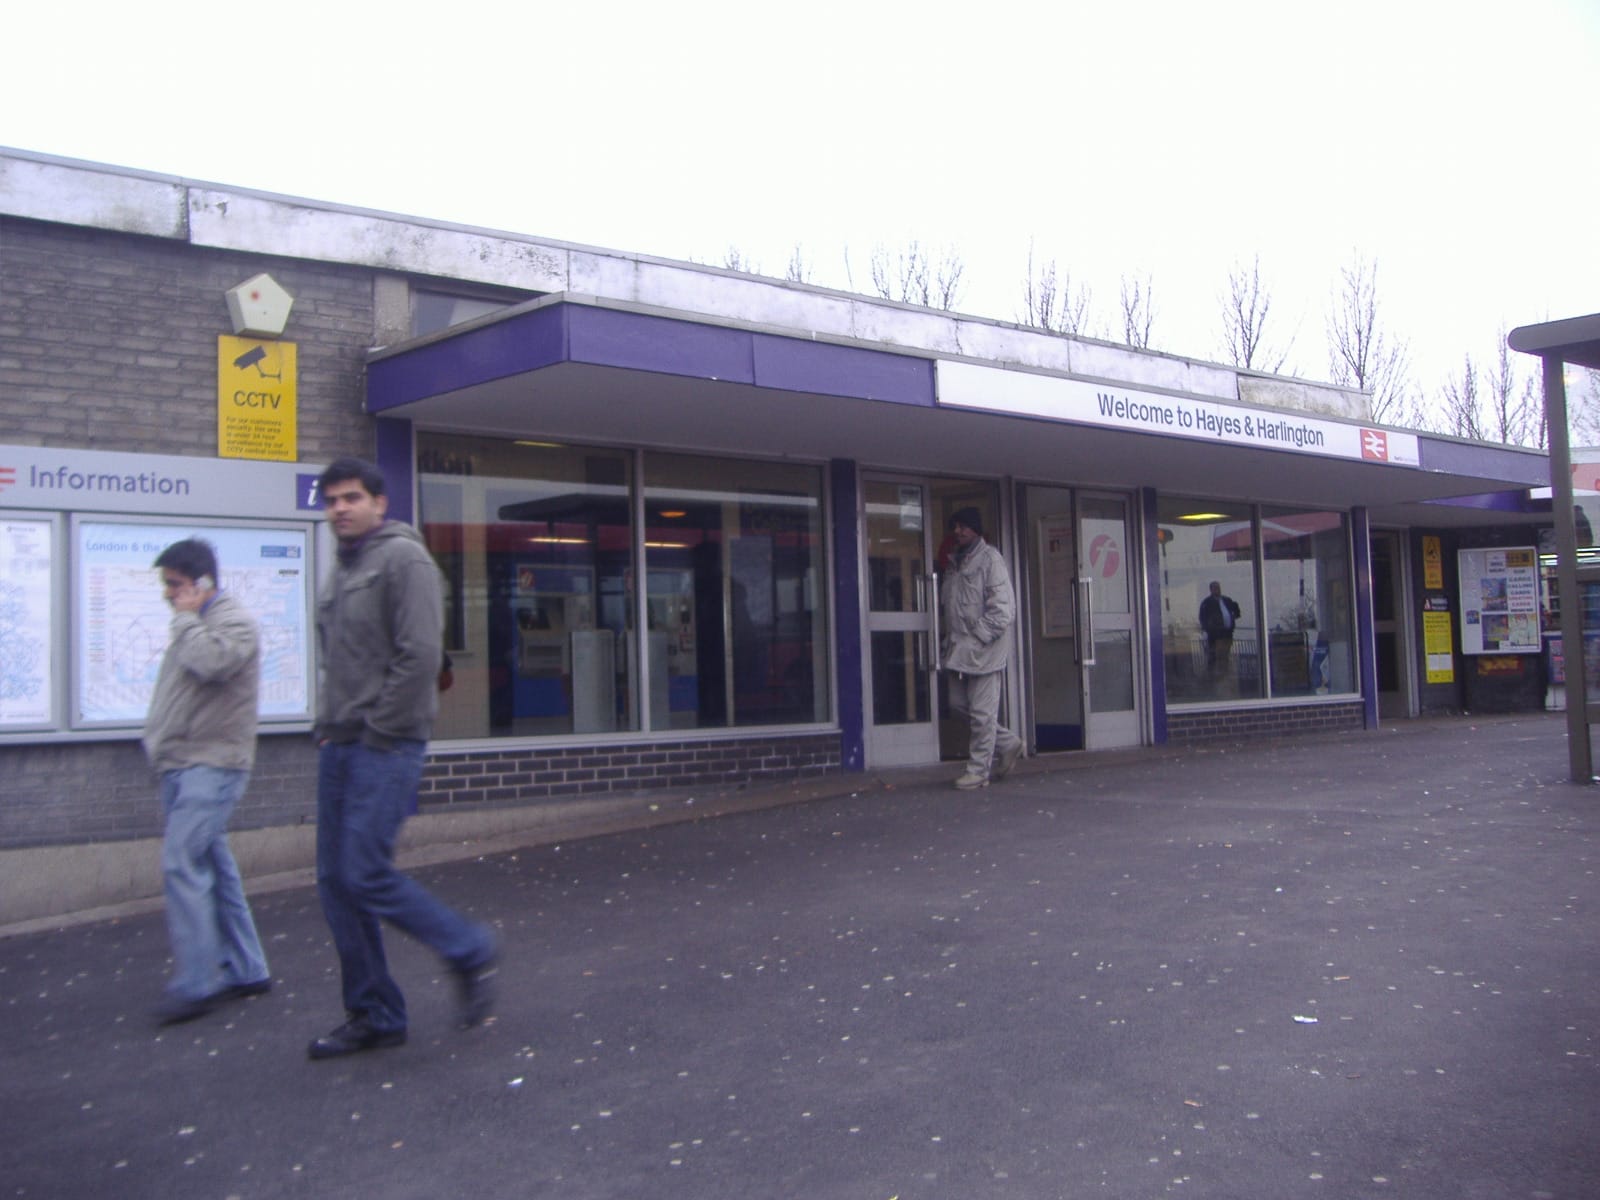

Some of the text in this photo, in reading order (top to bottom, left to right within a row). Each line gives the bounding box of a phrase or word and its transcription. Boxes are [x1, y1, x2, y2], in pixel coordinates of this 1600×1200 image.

[233, 390, 282, 409] CCTV
[1097, 393, 1325, 448] Welcome to Hayes & Harlington
[29, 465, 191, 496] Information
[86, 541, 128, 552] London
[142, 542, 161, 553] the
